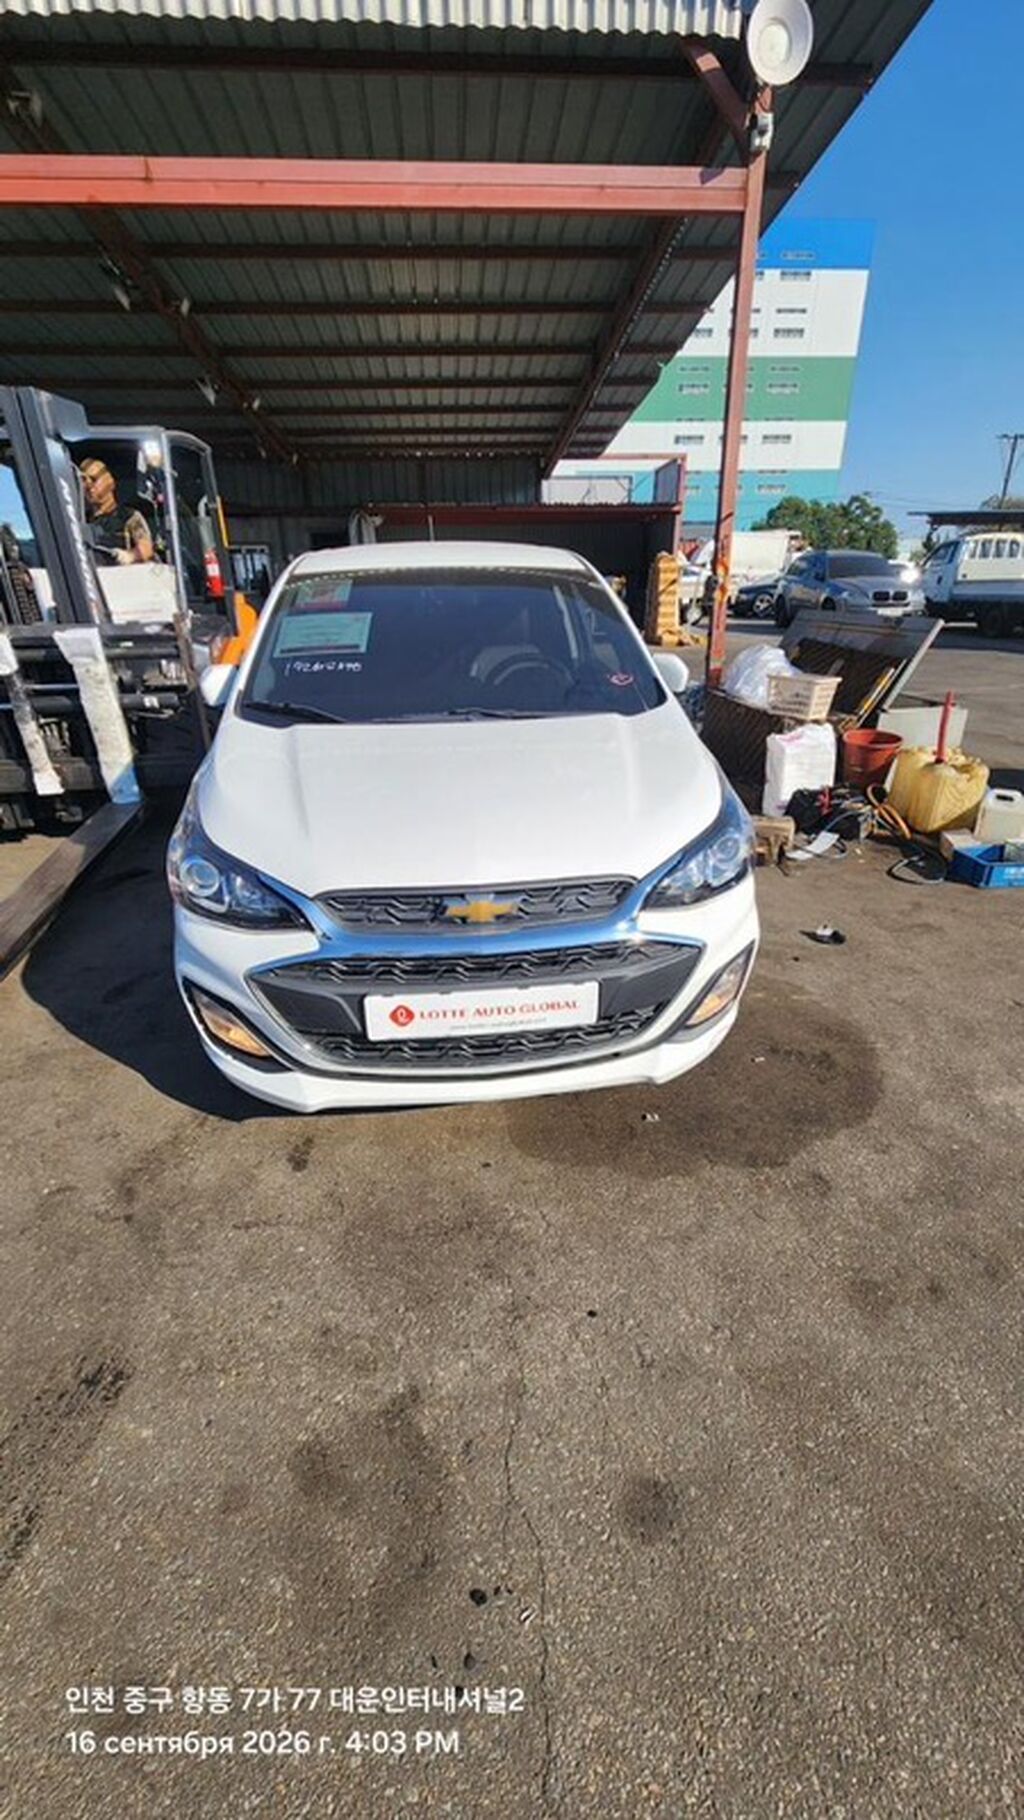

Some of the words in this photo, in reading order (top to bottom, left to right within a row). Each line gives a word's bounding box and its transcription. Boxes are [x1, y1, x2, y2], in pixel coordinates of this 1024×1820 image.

[420, 1009, 466, 1020] LOTTE
[473, 1005, 516, 1017] AUTO
[519, 1000, 580, 1013] GLOBAL
